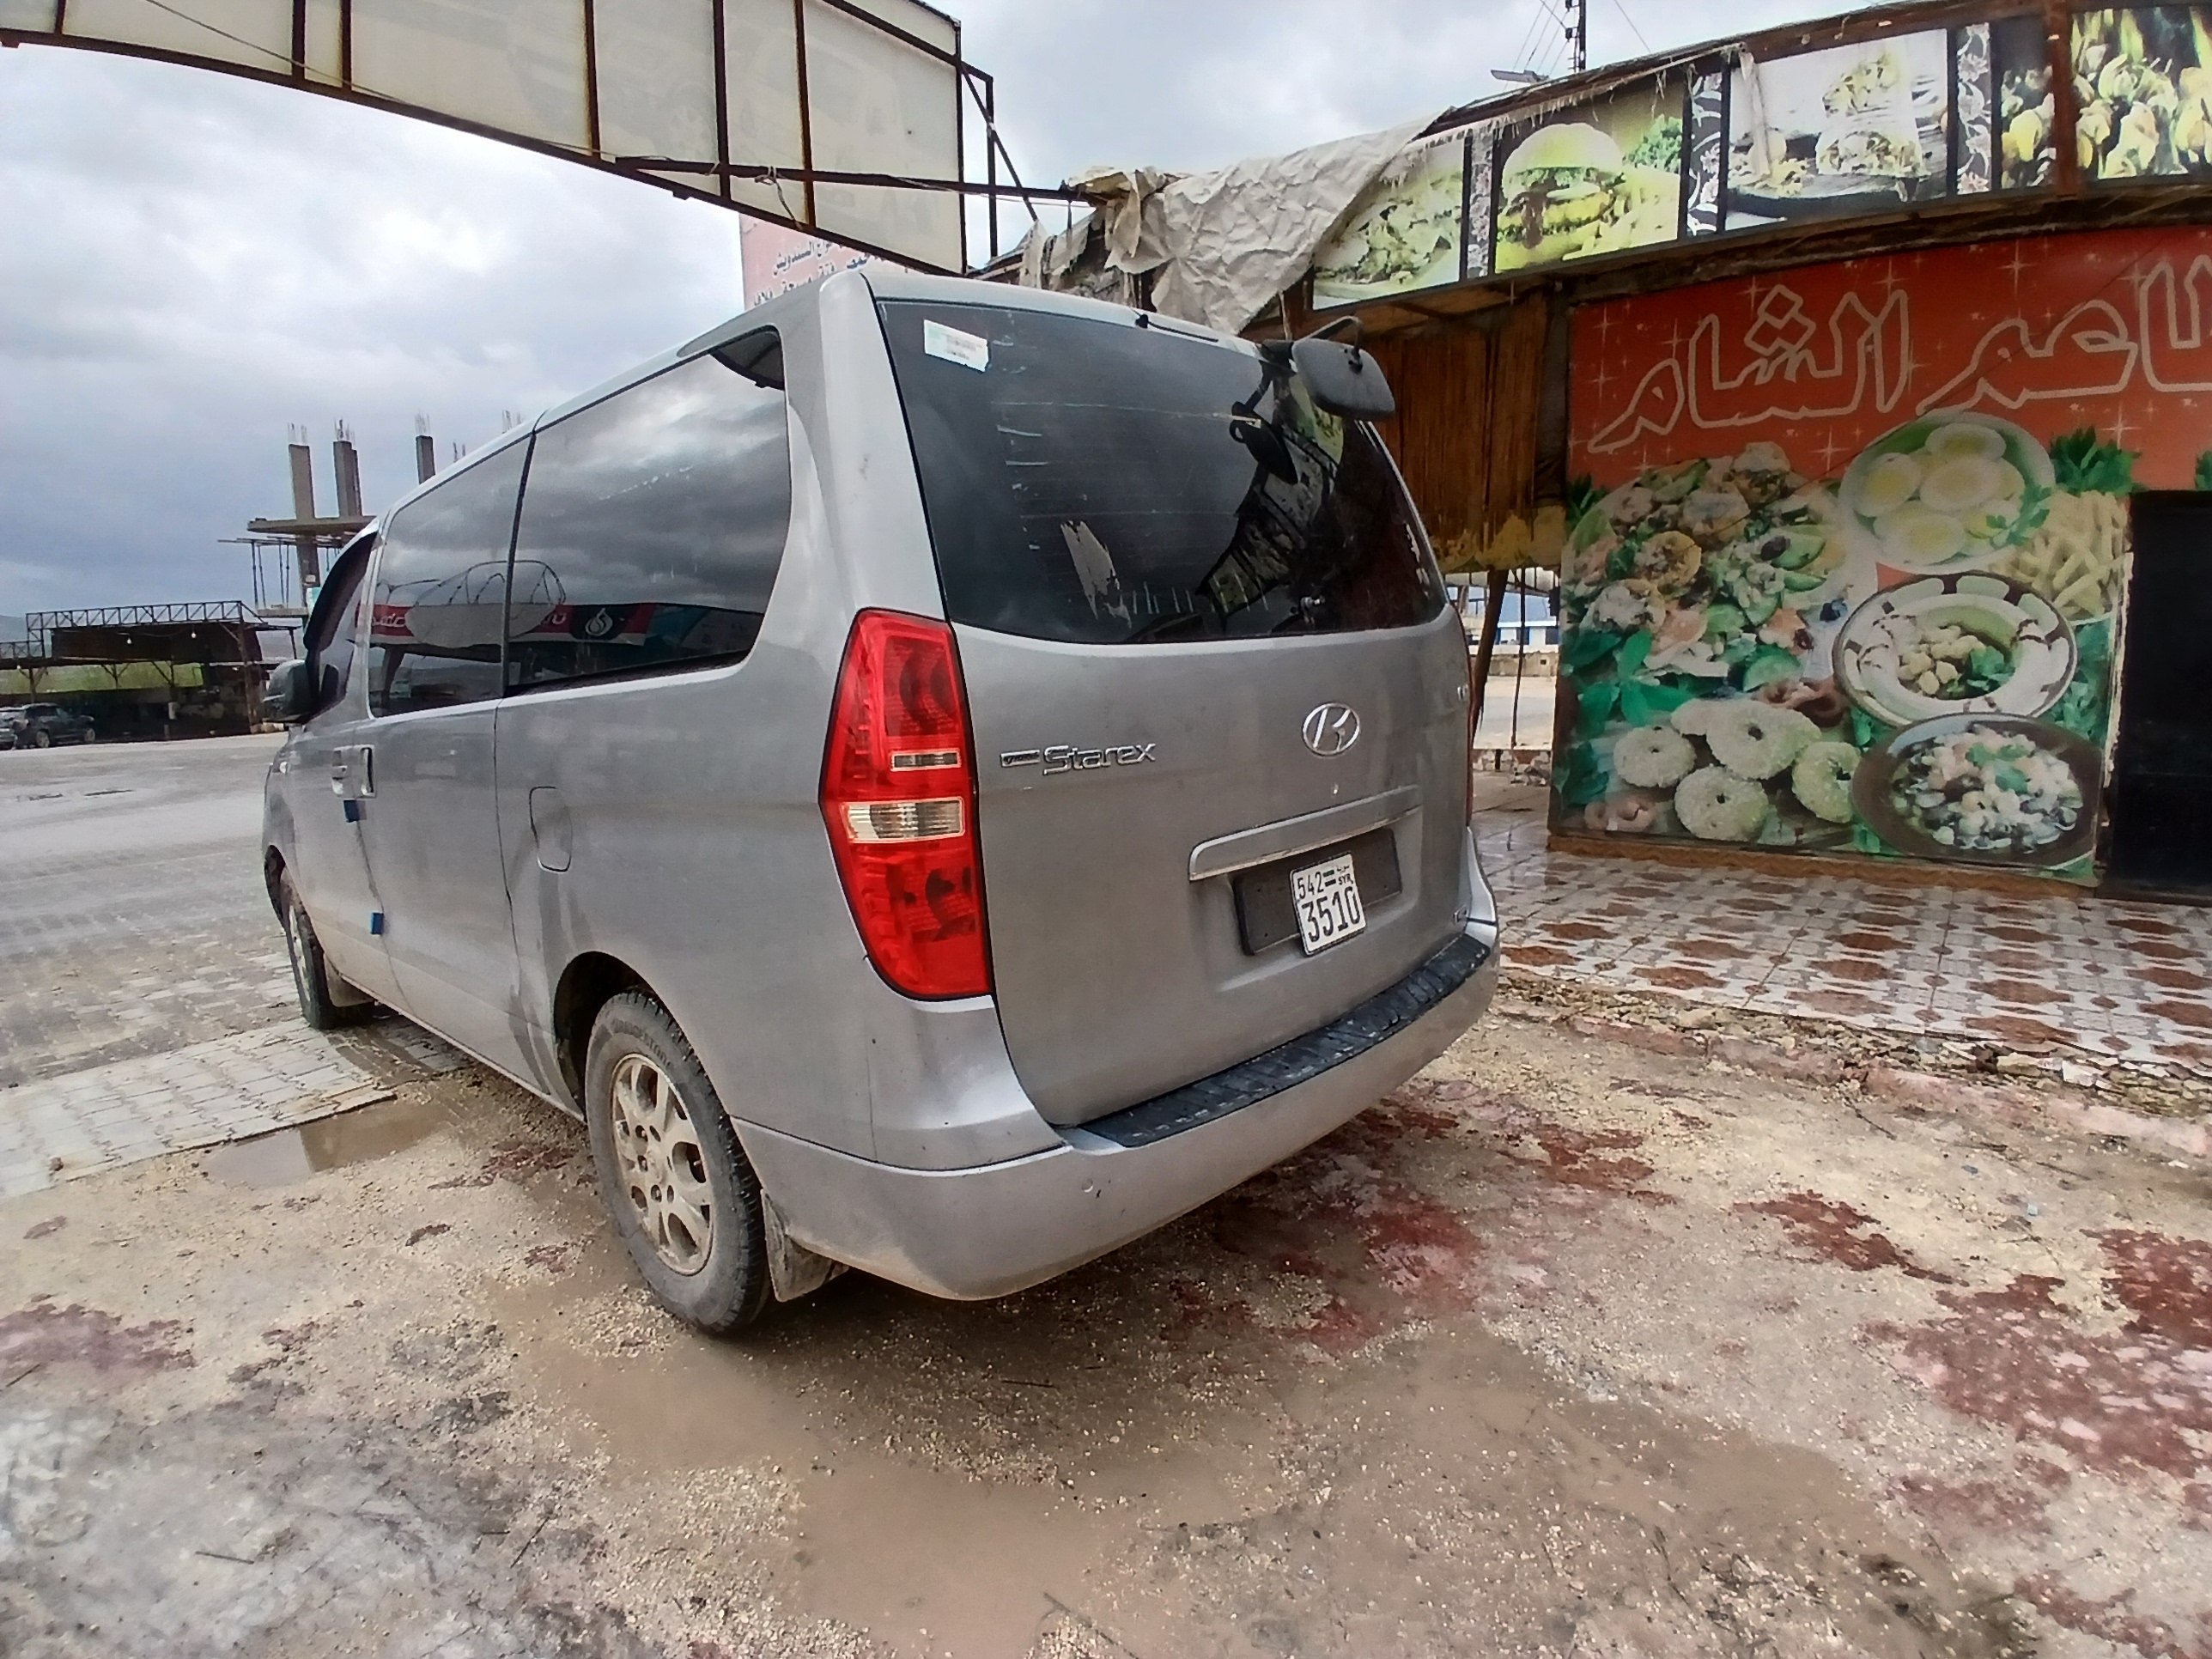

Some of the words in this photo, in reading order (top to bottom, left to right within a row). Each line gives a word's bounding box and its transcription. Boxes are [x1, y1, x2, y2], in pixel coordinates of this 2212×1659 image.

[1587, 284, 1910, 453] الشام
[1042, 743, 1156, 775] Starex
[1297, 871, 1324, 899] 542
[1301, 886, 1361, 943] 3510
